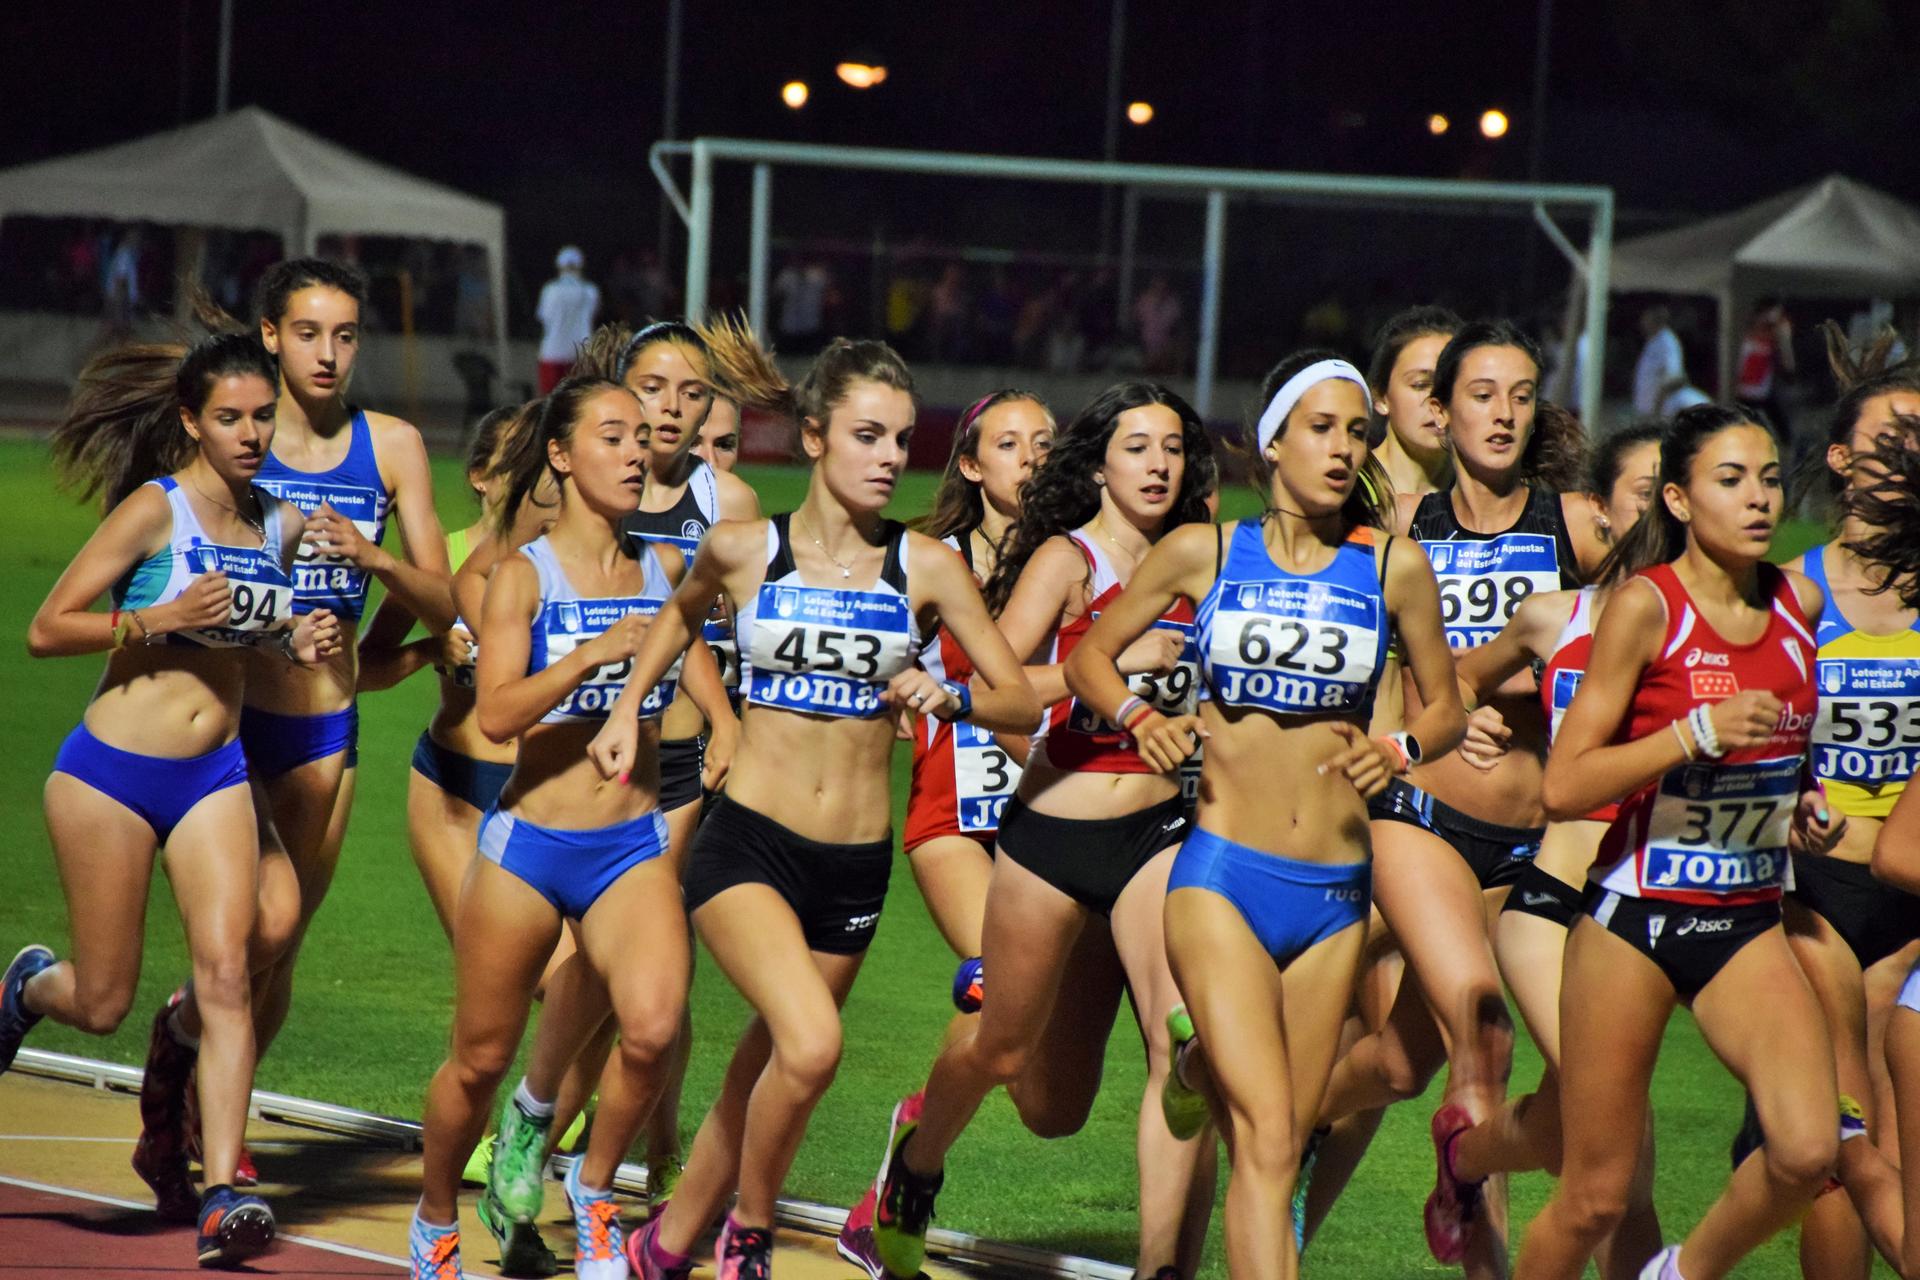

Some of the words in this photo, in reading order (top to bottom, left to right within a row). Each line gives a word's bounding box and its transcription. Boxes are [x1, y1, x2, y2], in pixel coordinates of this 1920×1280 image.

[286, 489, 320, 501] Loterías
[328, 493, 366, 505] Apuestas
[1494, 547, 1500, 557] y
[1501, 543, 1545, 554] Apuestas
[222, 563, 234, 572] del
[234, 564, 258, 575] Estado
[250, 556, 255, 568] y
[1457, 557, 1472, 568] del
[1474, 556, 1503, 568] Estado
[804, 596, 844, 609] Loterías
[845, 601, 852, 610] y
[853, 600, 897, 613] Apuestas
[1267, 597, 1282, 609] del
[1321, 593, 1367, 610] Apuestas
[1440, 576, 1534, 623] 698
[584, 606, 619, 616] Loterías
[803, 606, 818, 616] del
[820, 608, 854, 620] Estado
[587, 616, 601, 626] del
[774, 627, 881, 679] 453
[1238, 617, 1349, 675] 623
[1851, 667, 1893, 677] Loterías
[1895, 669, 1902, 679] y
[1852, 679, 1867, 689] del
[1869, 679, 1906, 689] Estado
[1832, 701, 1920, 748] 533
[981, 750, 1009, 792] 3
[1678, 800, 1779, 849] 377
[1695, 918, 1734, 932] asics
